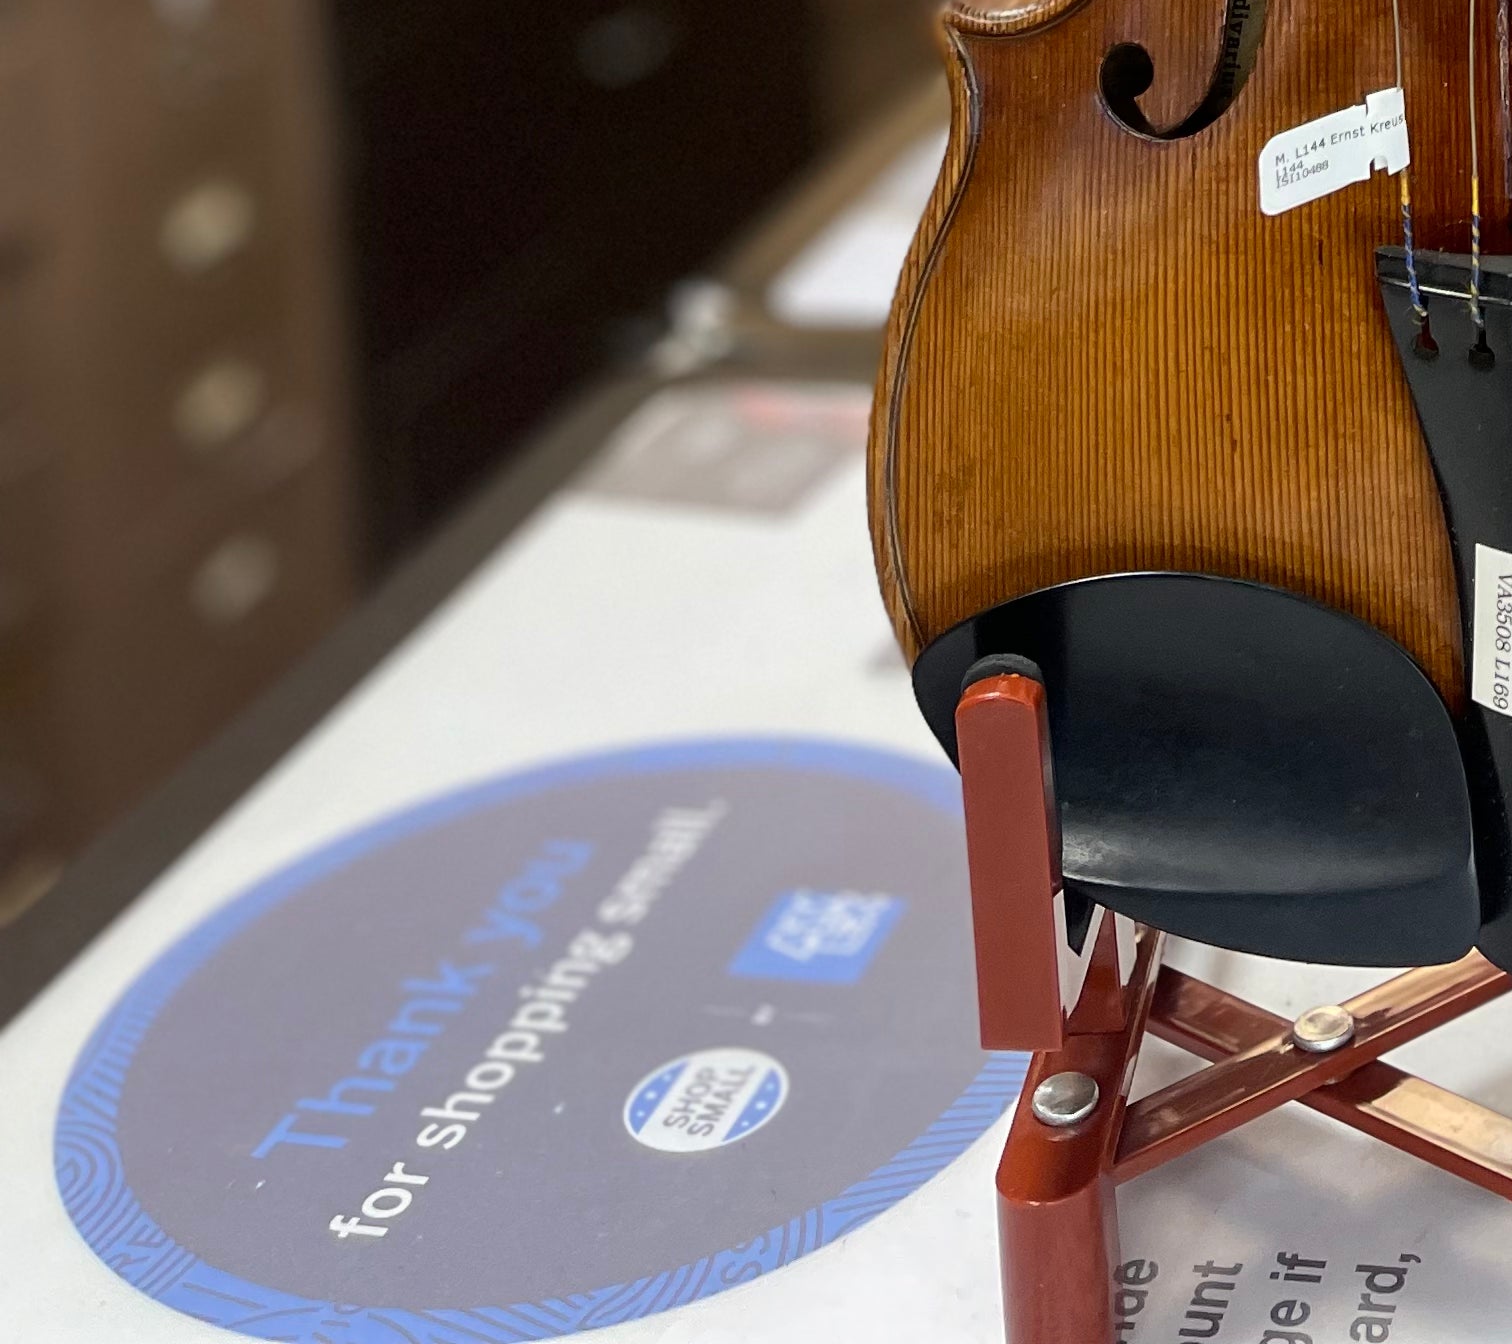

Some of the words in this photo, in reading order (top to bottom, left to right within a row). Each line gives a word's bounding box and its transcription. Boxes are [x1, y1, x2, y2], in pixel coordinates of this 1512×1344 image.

[1295, 137, 1326, 160] L144
[1330, 125, 1366, 146] Ernst
[1492, 657, 1511, 710] L169
[250, 957, 495, 1160] Thank
[465, 838, 595, 950] you
[329, 1161, 430, 1238] for
[416, 929, 634, 1150] shopping
[662, 1066, 718, 1129] SHOP
[686, 1064, 758, 1137] SMALL
[1269, 1251, 1328, 1283] if
